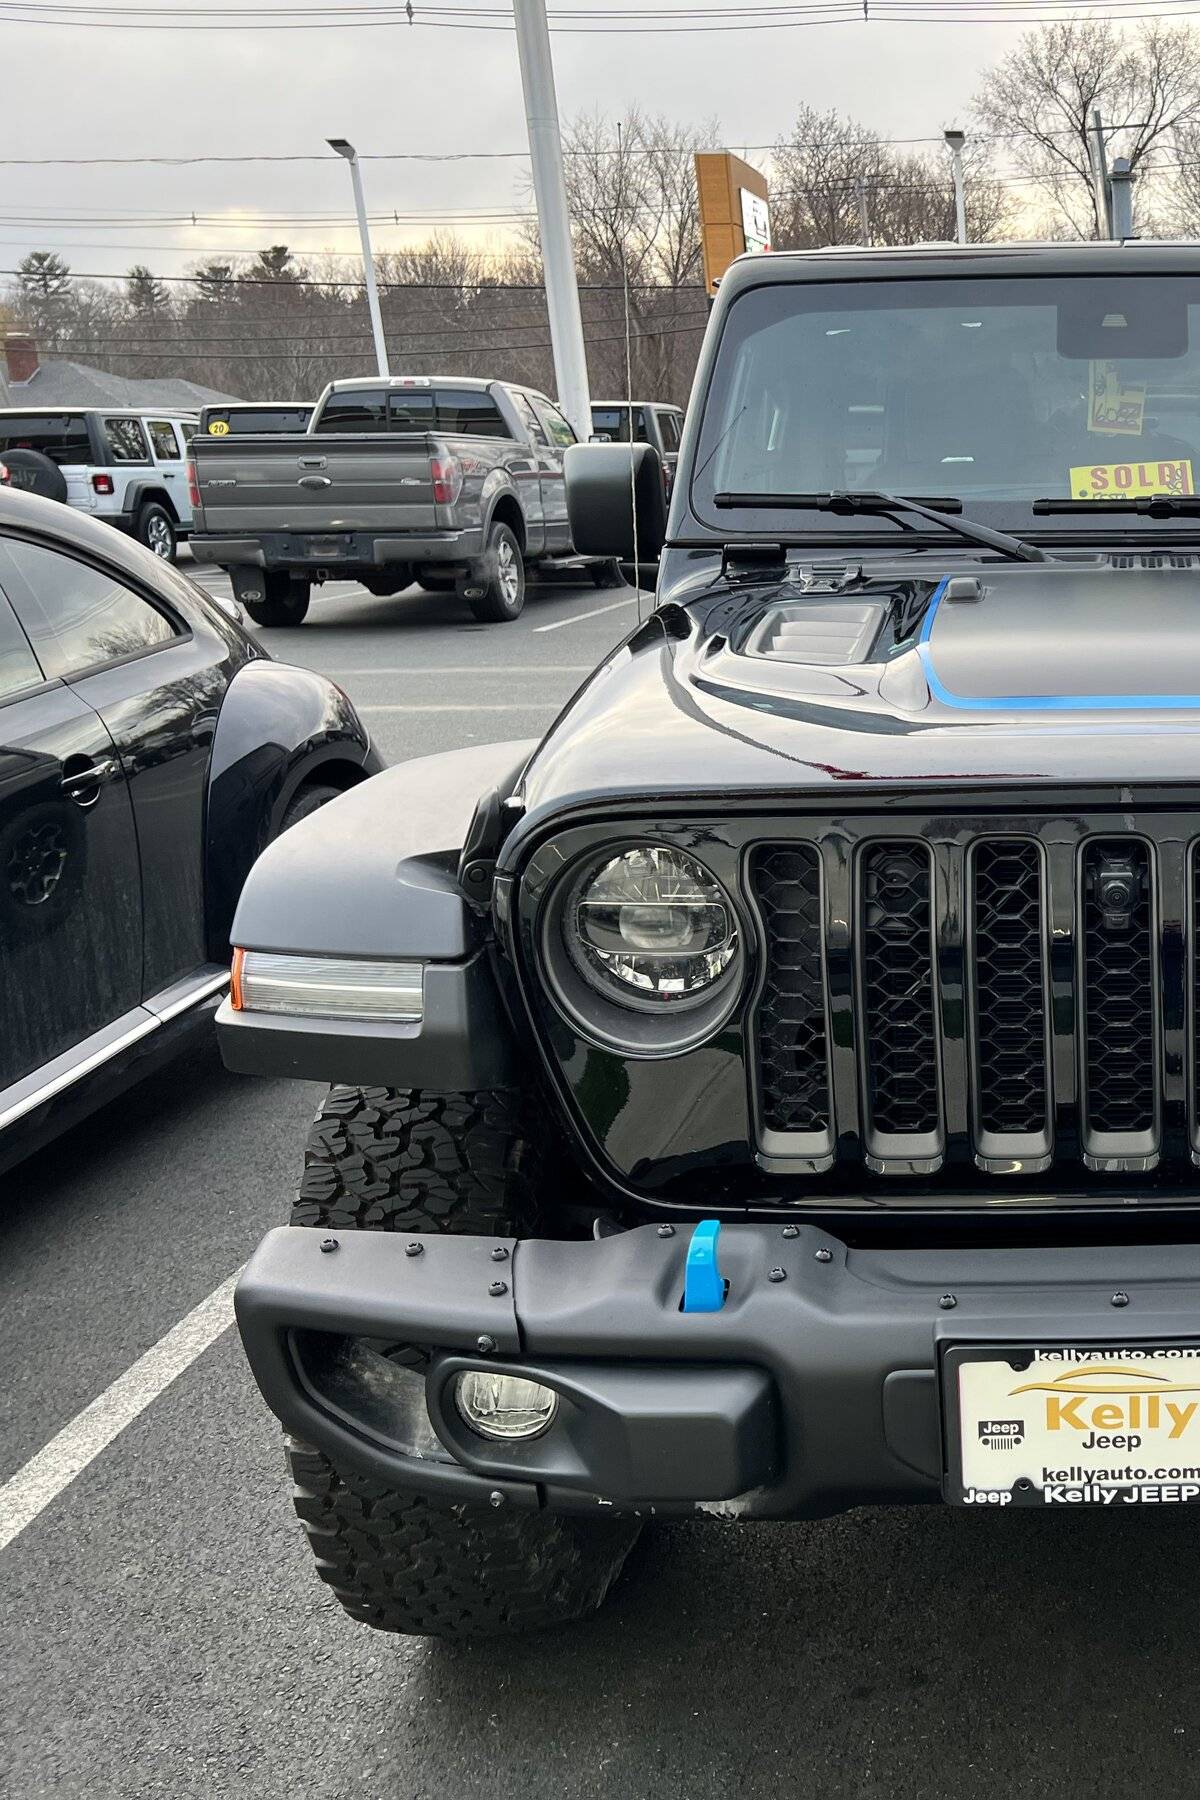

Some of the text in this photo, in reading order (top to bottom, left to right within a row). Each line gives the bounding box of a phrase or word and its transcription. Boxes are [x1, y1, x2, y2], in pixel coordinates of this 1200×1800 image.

[1090, 463, 1178, 490] SOLD
[1046, 1395, 1199, 1439] Kelly
[983, 1421, 1020, 1435] Jeep
[1082, 1431, 1142, 1452] Jeep
[963, 1489, 1012, 1506] Jeep
[1044, 1484, 1200, 1505] Kelly JEEP
